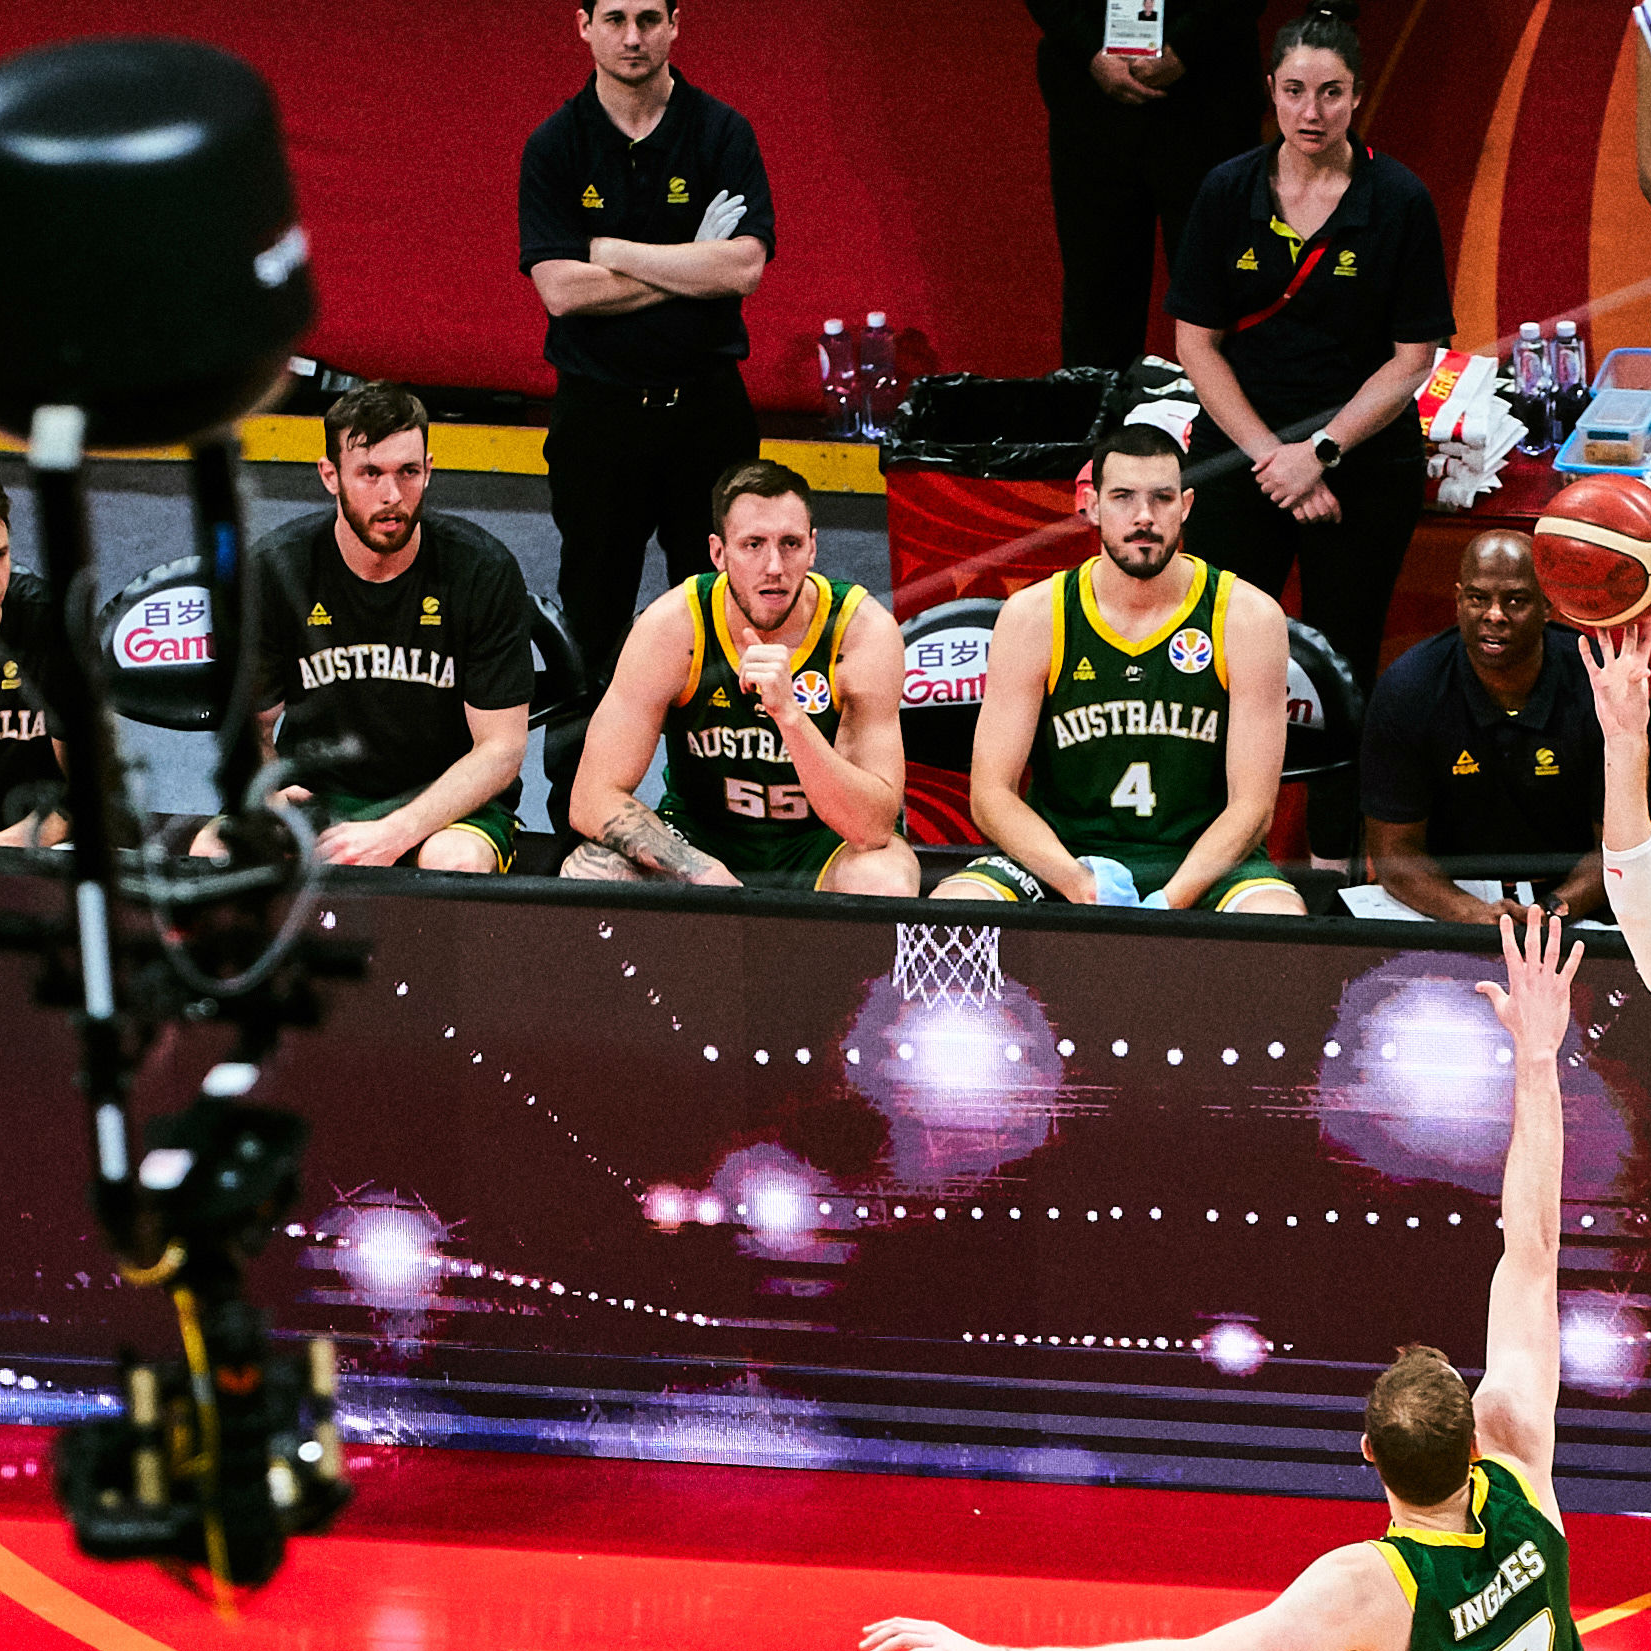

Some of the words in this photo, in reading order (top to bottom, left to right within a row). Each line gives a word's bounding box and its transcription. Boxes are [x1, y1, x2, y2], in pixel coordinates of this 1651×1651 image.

[144, 599, 205, 627] 百岁
[124, 627, 217, 663] Gant
[917, 640, 990, 668] 百岁
[299, 644, 455, 690] AUSTRALIA
[902, 668, 987, 706] Gant
[686, 725, 793, 763] AUSTRA
[1052, 699, 1219, 750] AUSTRALIA
[723, 776, 810, 820] 55
[1110, 762, 1157, 818] 4
[1449, 1539, 1548, 1643] INGLES
